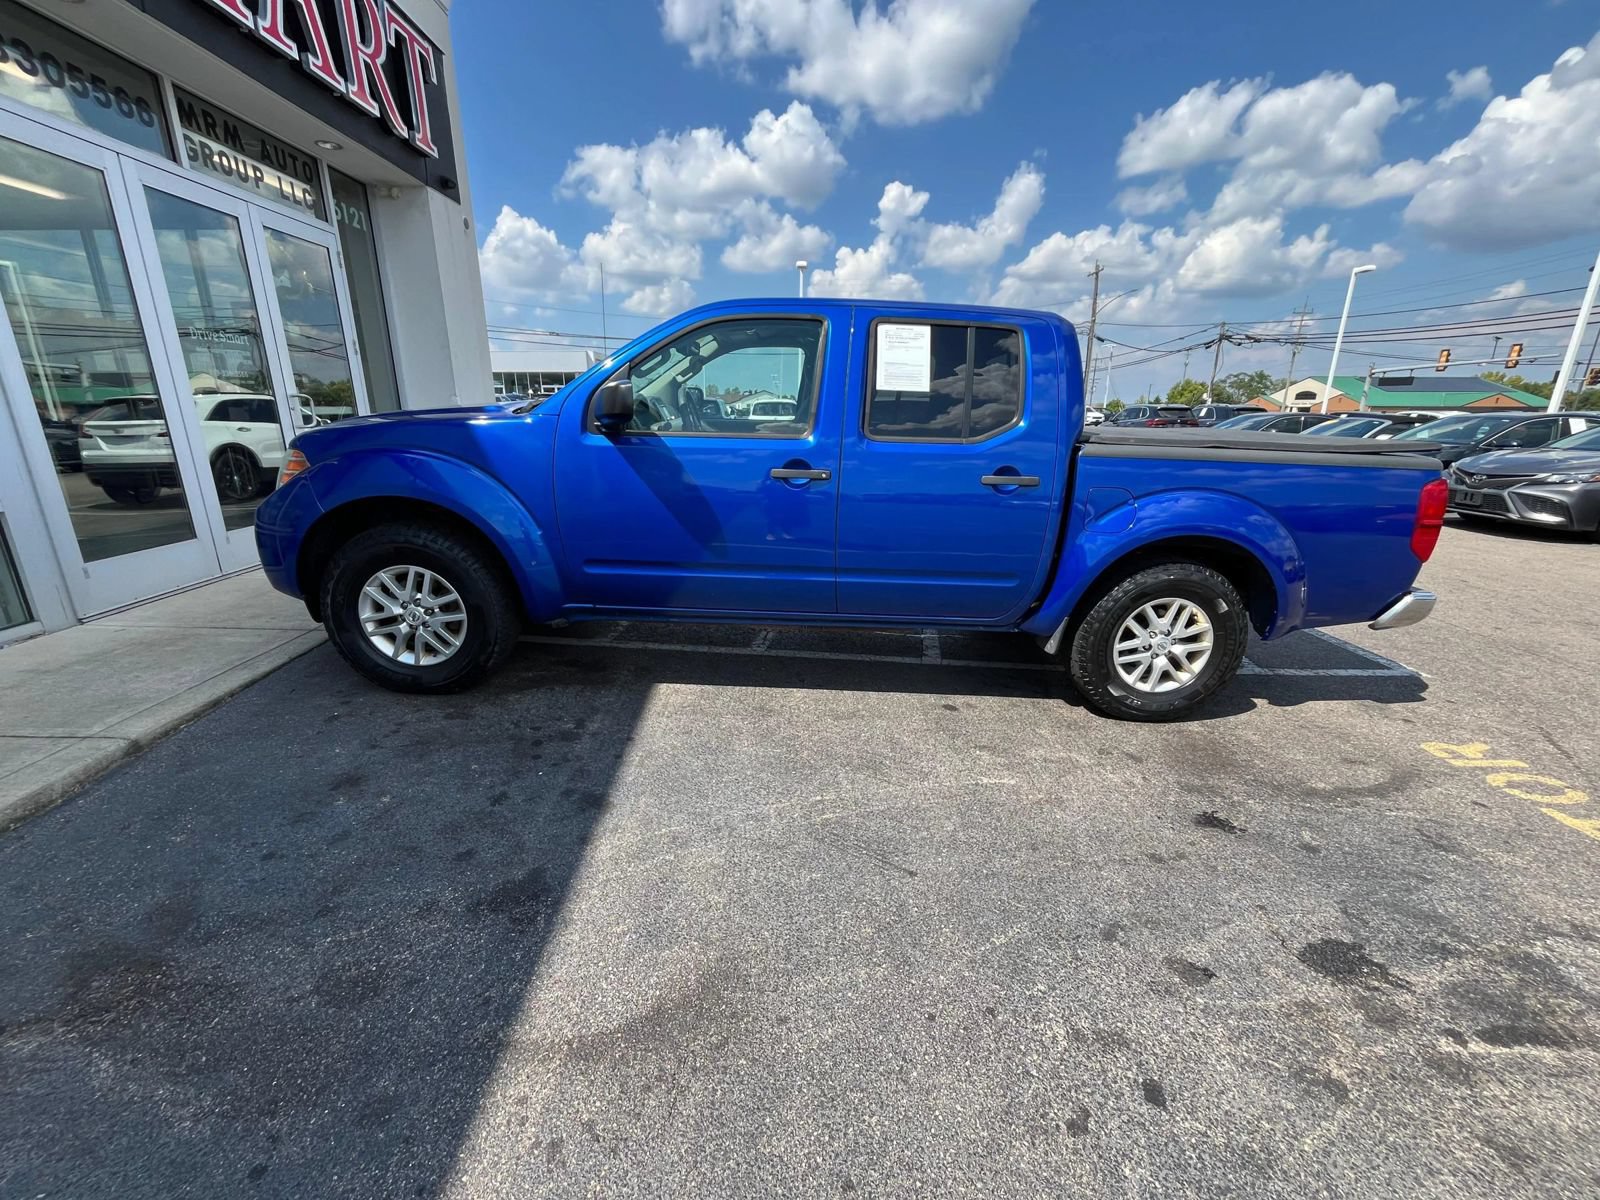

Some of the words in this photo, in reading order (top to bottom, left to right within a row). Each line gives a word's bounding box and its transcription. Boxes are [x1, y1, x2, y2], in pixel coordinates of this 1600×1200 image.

[178, 97, 246, 153] MRM
[260, 139, 315, 183] AUTO
[182, 132, 265, 189] GROUP
[277, 175, 316, 210] LLC
